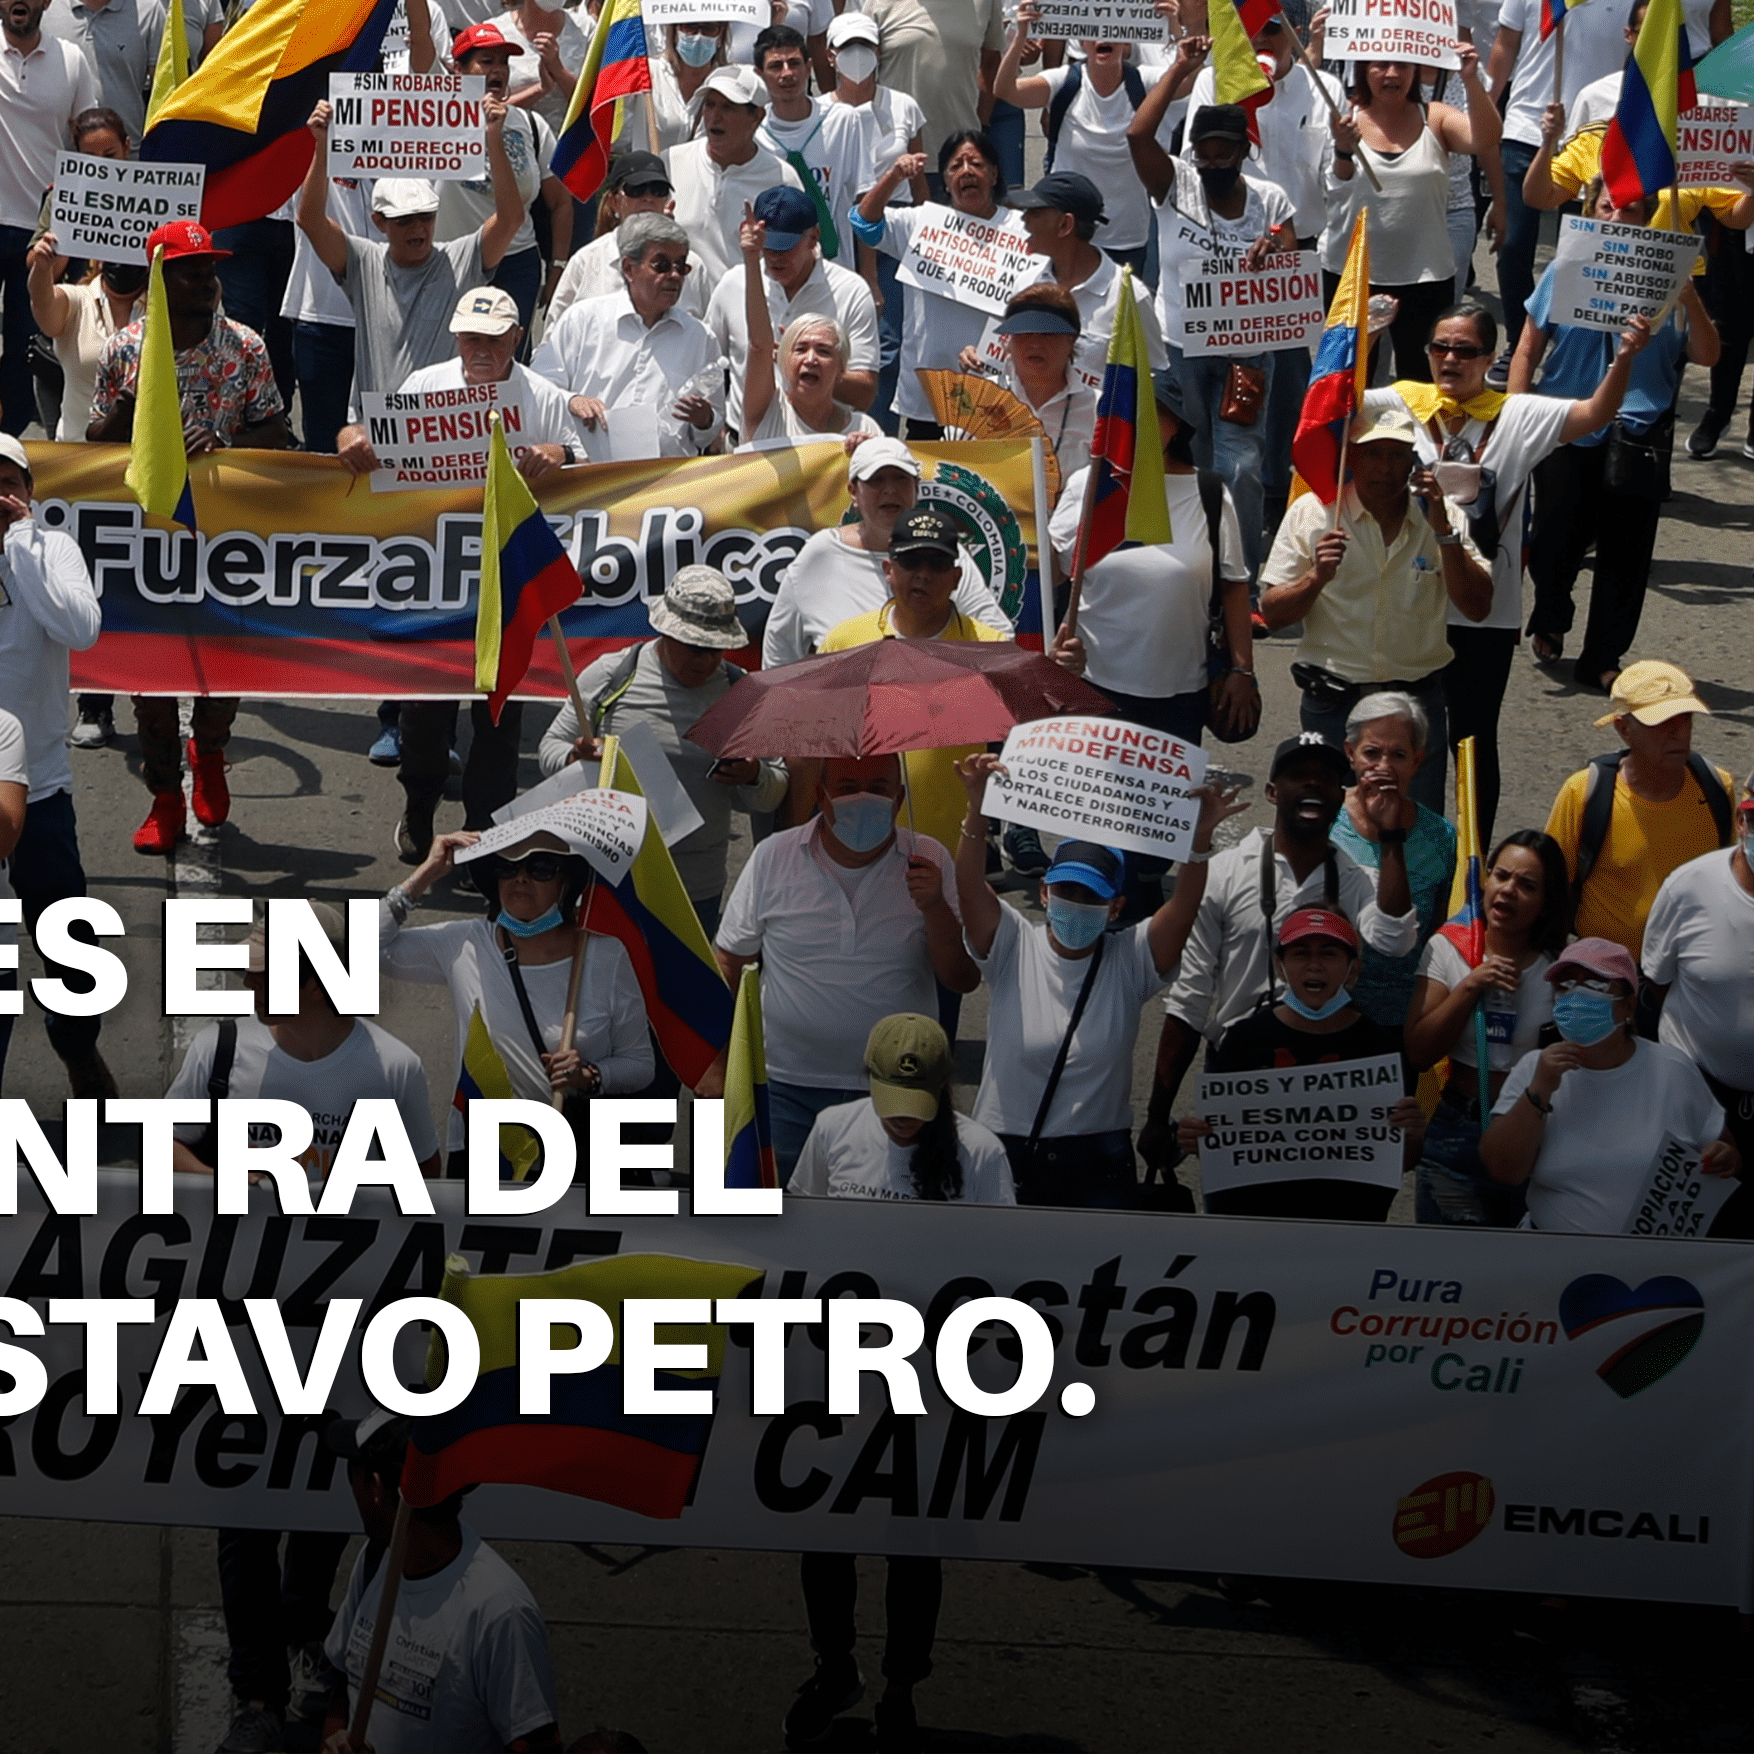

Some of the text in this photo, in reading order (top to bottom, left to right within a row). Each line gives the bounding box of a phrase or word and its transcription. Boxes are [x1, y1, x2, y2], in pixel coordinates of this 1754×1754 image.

[1327, 27, 1457, 49] ES MI DERECHO
[1347, 41, 1442, 59] ADQUIRIDO
[353, 73, 462, 93] #SIN ROBARSE
[335, 93, 481, 128] MI PENSIÓN
[331, 139, 483, 156] ES MI DERECHO
[59, 158, 201, 187] ¡DIOS Y PATRIA!
[352, 155, 462, 171] ADQUIRIDO
[58, 189, 198, 217] EL ESMAD SE
[54, 208, 115, 230] QUEDA
[943, 214, 965, 233] UN
[1569, 218, 1596, 233] SIN
[918, 225, 998, 264] ANTISOCIAL
[1602, 240, 1674, 261] SIN ROBO
[915, 260, 946, 280] QUE
[924, 246, 996, 280] DELINQUIR
[1201, 258, 1234, 276] #SIN
[1594, 252, 1676, 274] PENSIONAL
[1186, 268, 1319, 309] MI PENSIÓN
[1581, 266, 1671, 290] SIN ABUSOS
[1594, 280, 1668, 302] TENDEROS
[1589, 298, 1615, 311] SIN
[1184, 310, 1323, 334] ES MI DERECHO
[1206, 326, 1305, 347] ADQUIRIDO
[955, 491, 1005, 577] COLOMBIA
[1030, 721, 1187, 761] #RENUNCIE
[1015, 735, 1193, 781] MINDEFENSA
[1018, 767, 1158, 808] LOS CIUDADANOS
[1073, 765, 1146, 790] DEFENSA
[1016, 798, 1177, 844] NARCOTERRORISMO
[1089, 798, 1192, 832] DISIDENCIAS
[1201, 1063, 1399, 1100] ¡DIOS PATRIA!
[1241, 1104, 1359, 1126] ESMAD
[1204, 1125, 1402, 1150] QUEDA CON SUS
[1232, 1145, 1375, 1167] FUNCIONES
[839, 1181, 877, 1198] GRAN
[1367, 1268, 1464, 1305] Pura
[1329, 1305, 1559, 1348] Corrupción
[1364, 1342, 1525, 1395] por Cali
[1503, 1503, 1710, 1545] EMCALI
